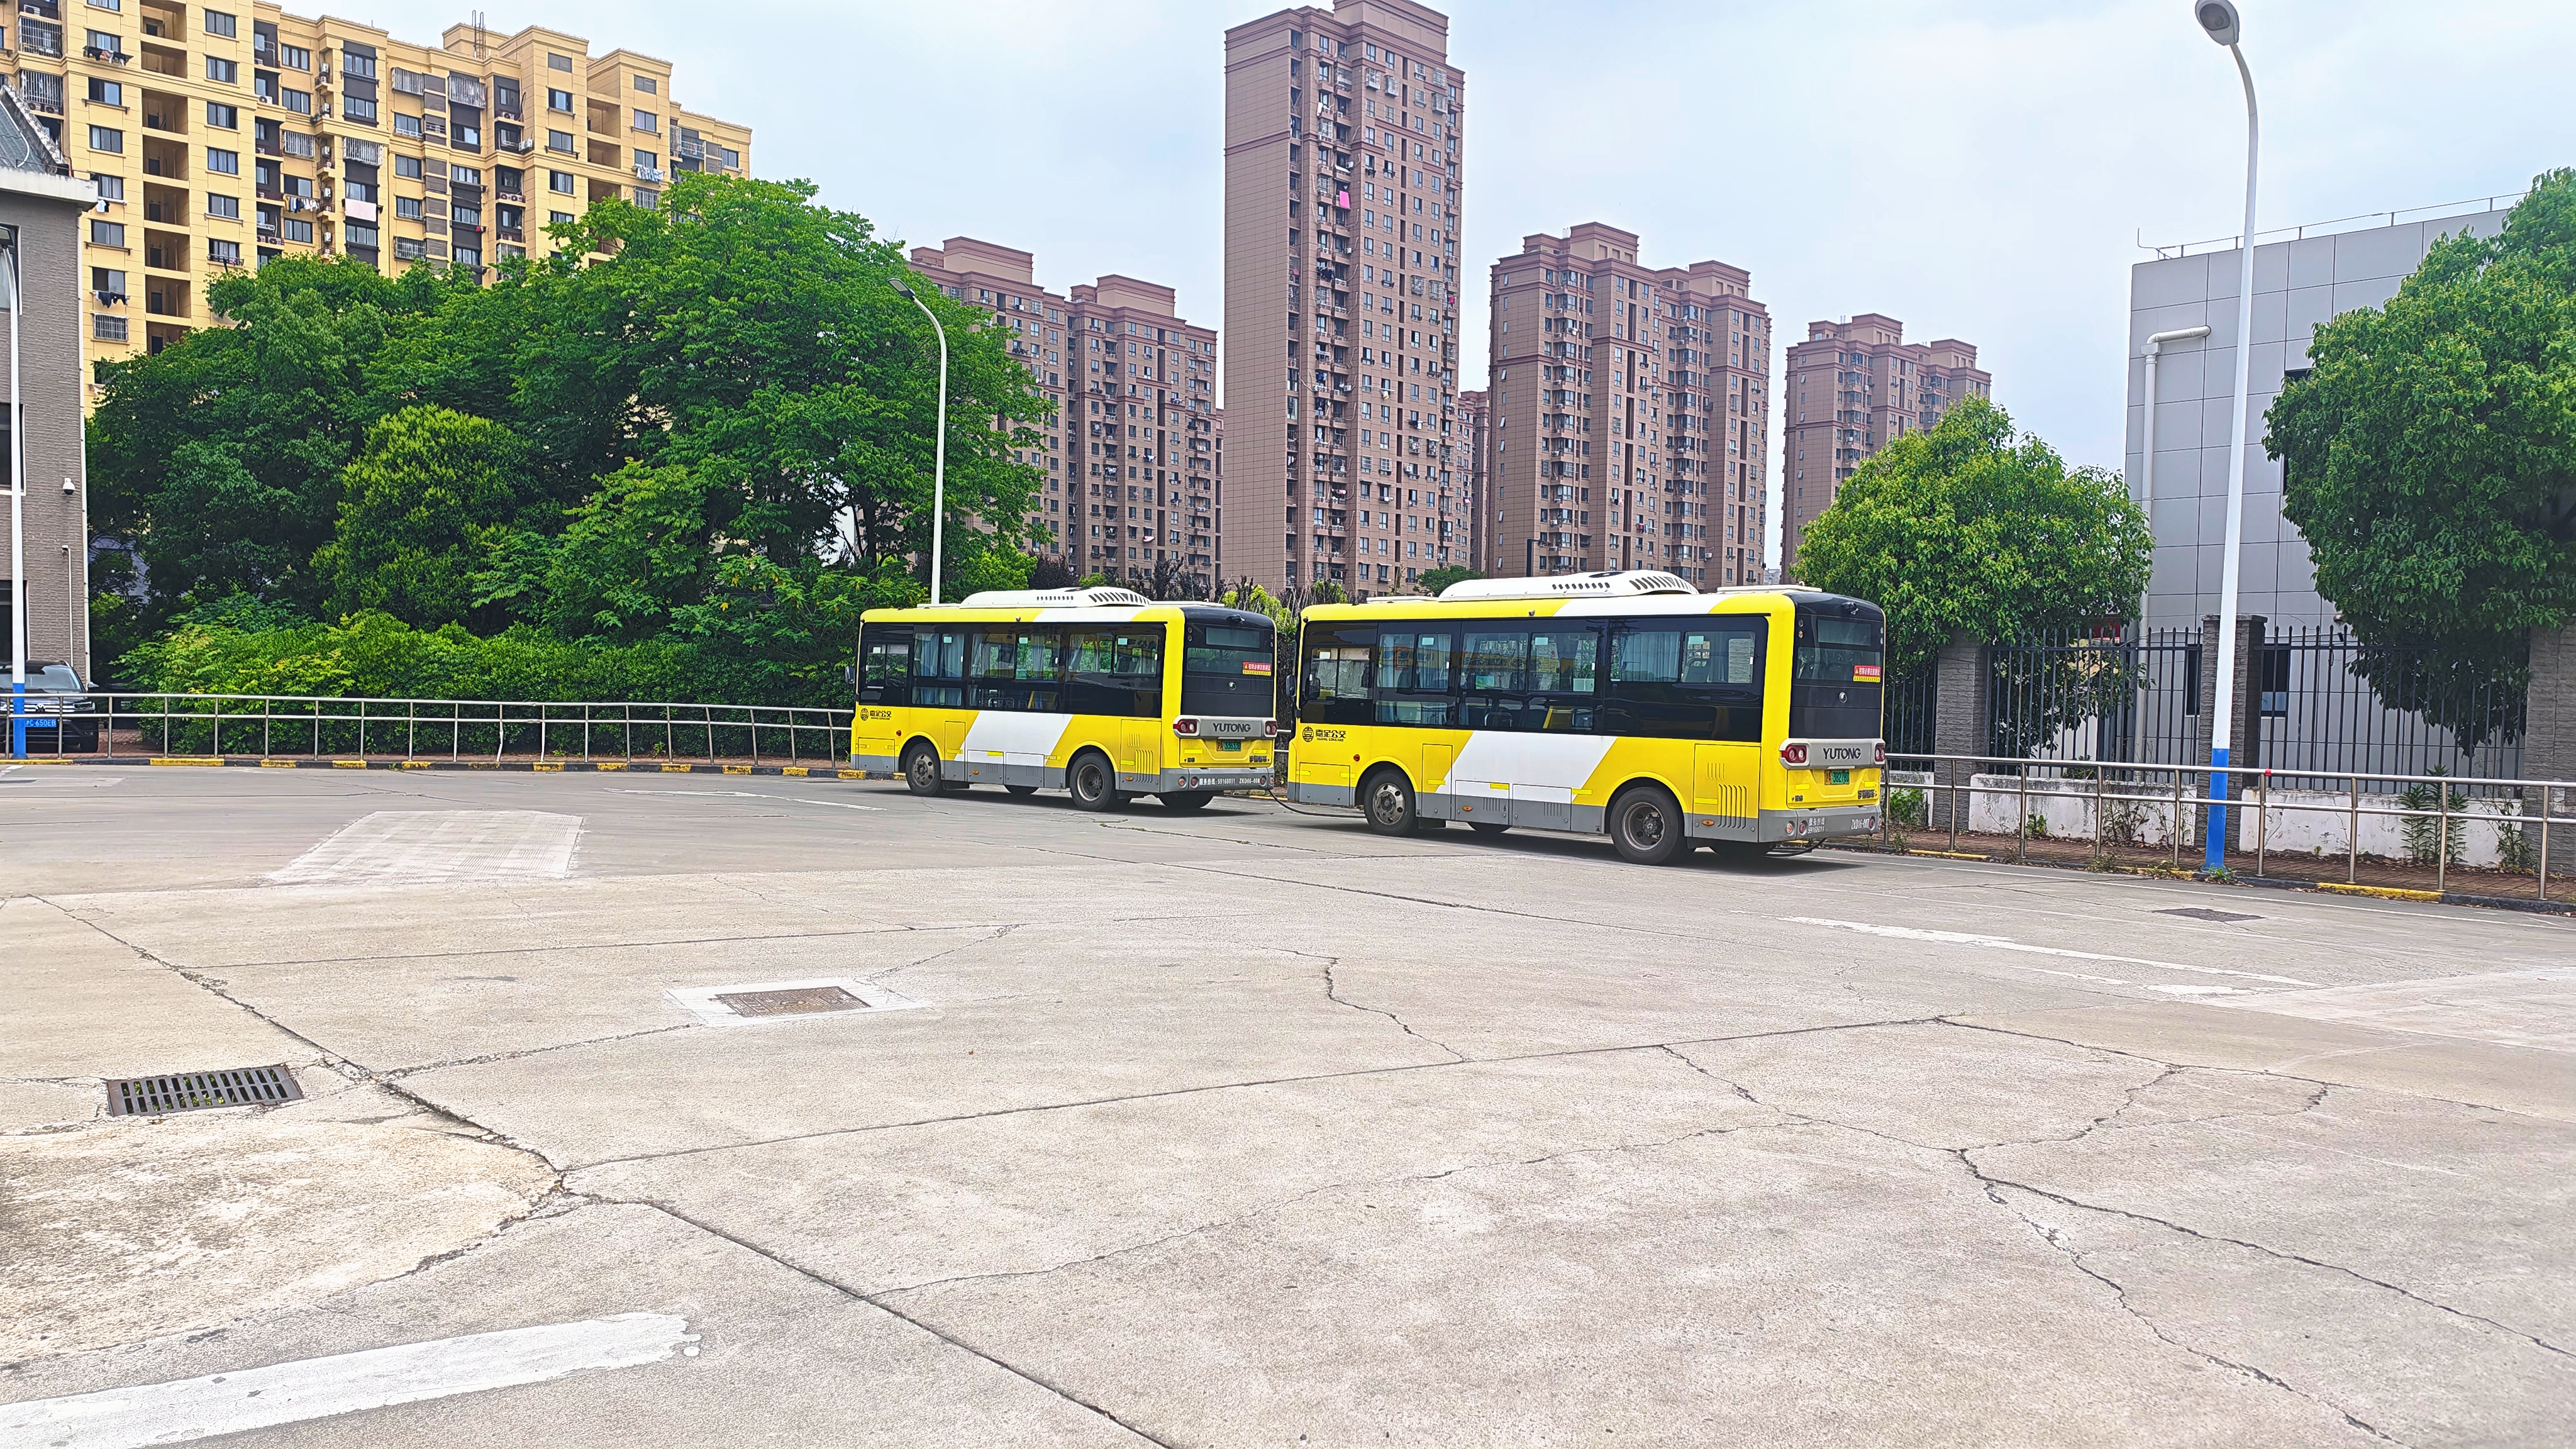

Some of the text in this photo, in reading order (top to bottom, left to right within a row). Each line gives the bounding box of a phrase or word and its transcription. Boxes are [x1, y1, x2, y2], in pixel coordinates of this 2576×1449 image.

[1213, 723, 1251, 733] YUTONG
[1315, 729, 1346, 738] 嘉定公交
[1823, 748, 1861, 760] YUTONG
